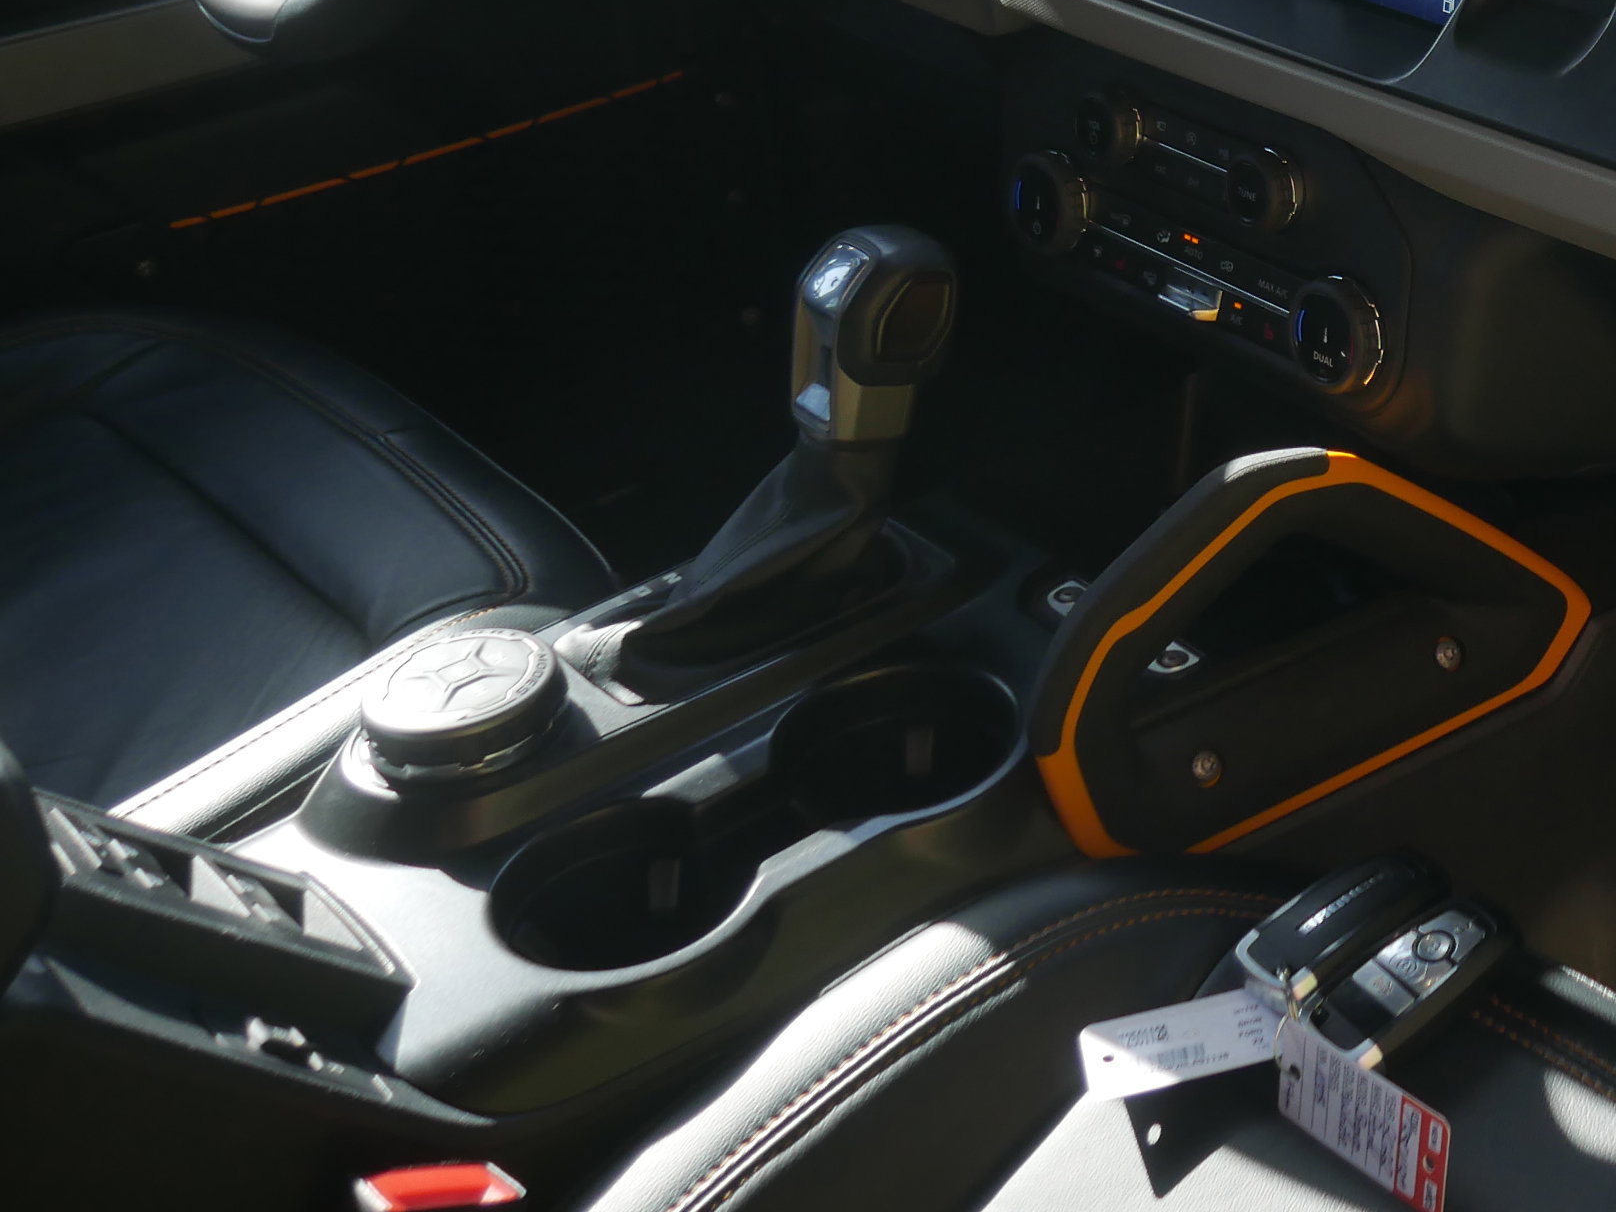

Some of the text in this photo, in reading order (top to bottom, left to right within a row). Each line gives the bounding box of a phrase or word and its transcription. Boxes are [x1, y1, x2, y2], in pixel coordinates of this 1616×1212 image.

[1236, 185, 1257, 203] TUNE
[1313, 350, 1334, 368] DUAL
[515, 649, 548, 696] MODES
